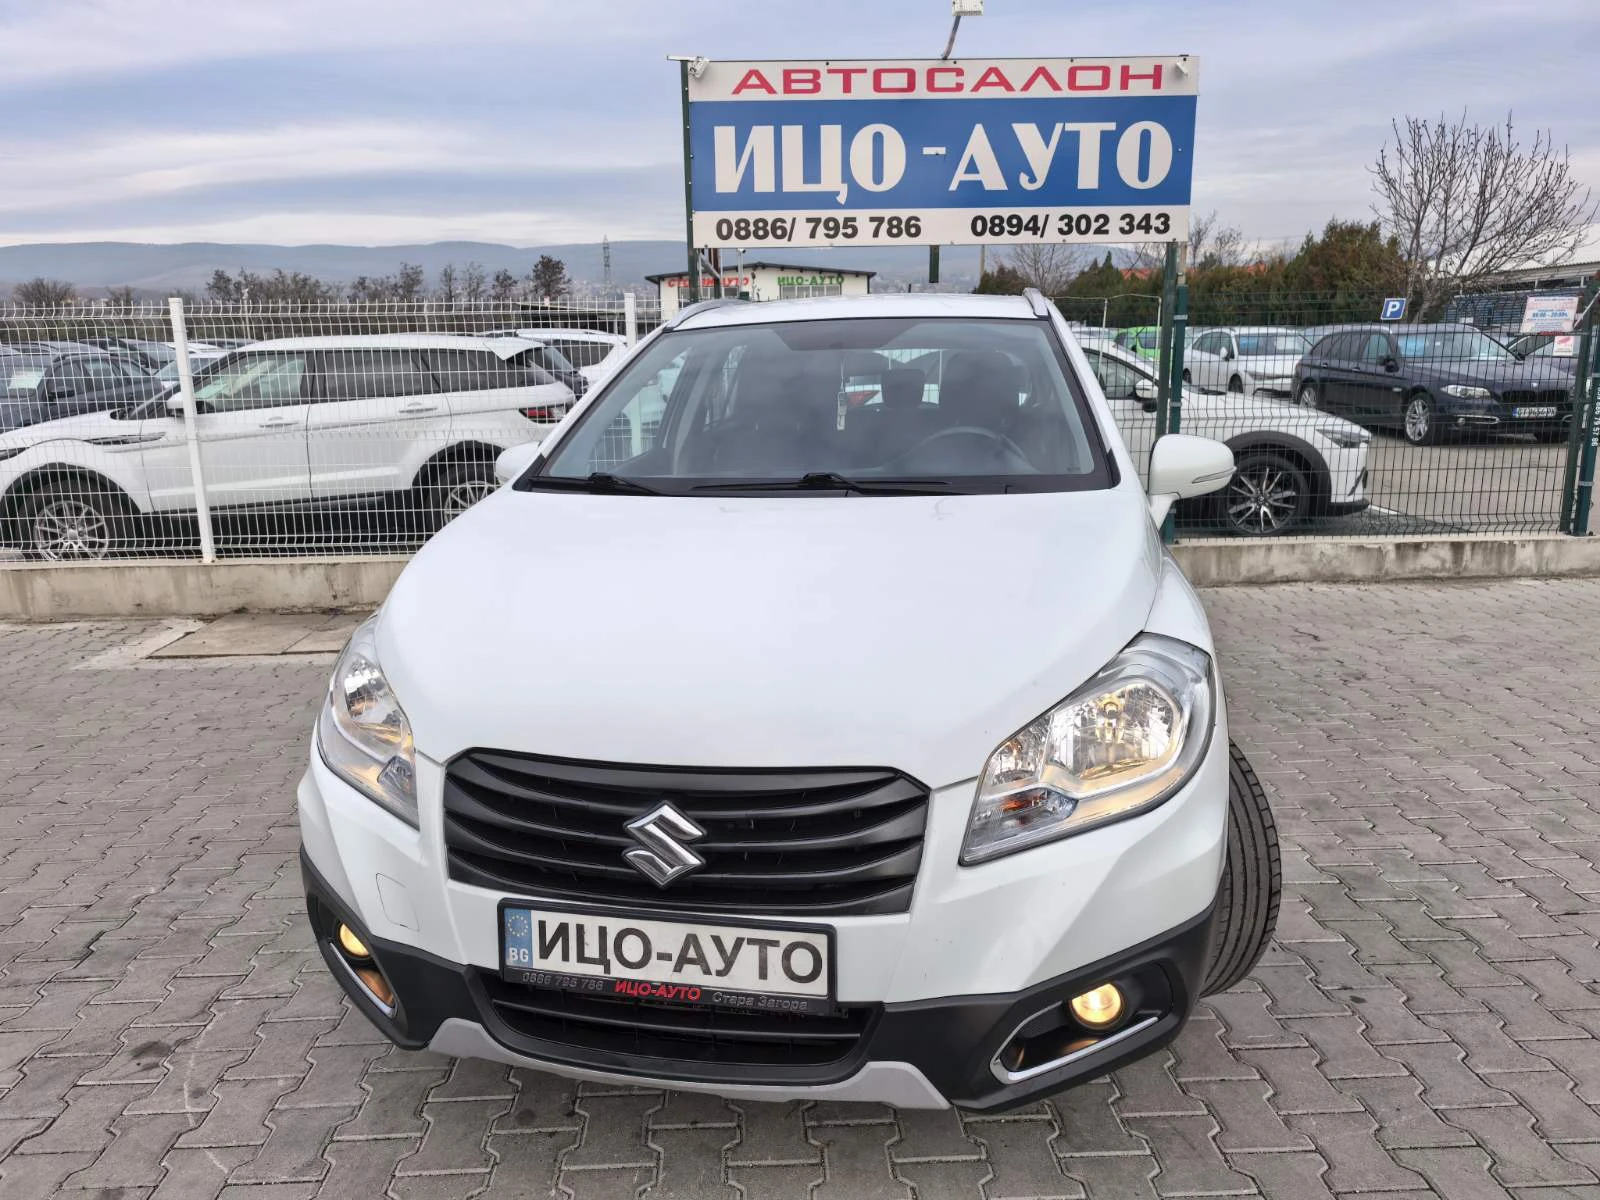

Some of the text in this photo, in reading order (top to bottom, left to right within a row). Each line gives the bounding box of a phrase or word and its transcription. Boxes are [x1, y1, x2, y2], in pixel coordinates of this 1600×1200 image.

[731, 64, 1163, 95] АВТОСАЛОН
[716, 216, 921, 241] 0886/ 795 786
[971, 213, 1170, 237] 0894/ 302 343
[777, 275, 844, 285] ИЦО-АУТО
[1386, 301, 1400, 317] P
[508, 947, 529, 963] BG
[537, 919, 823, 984] ИЦО-АУТО
[615, 980, 701, 1000] ИЦО-АУТО
